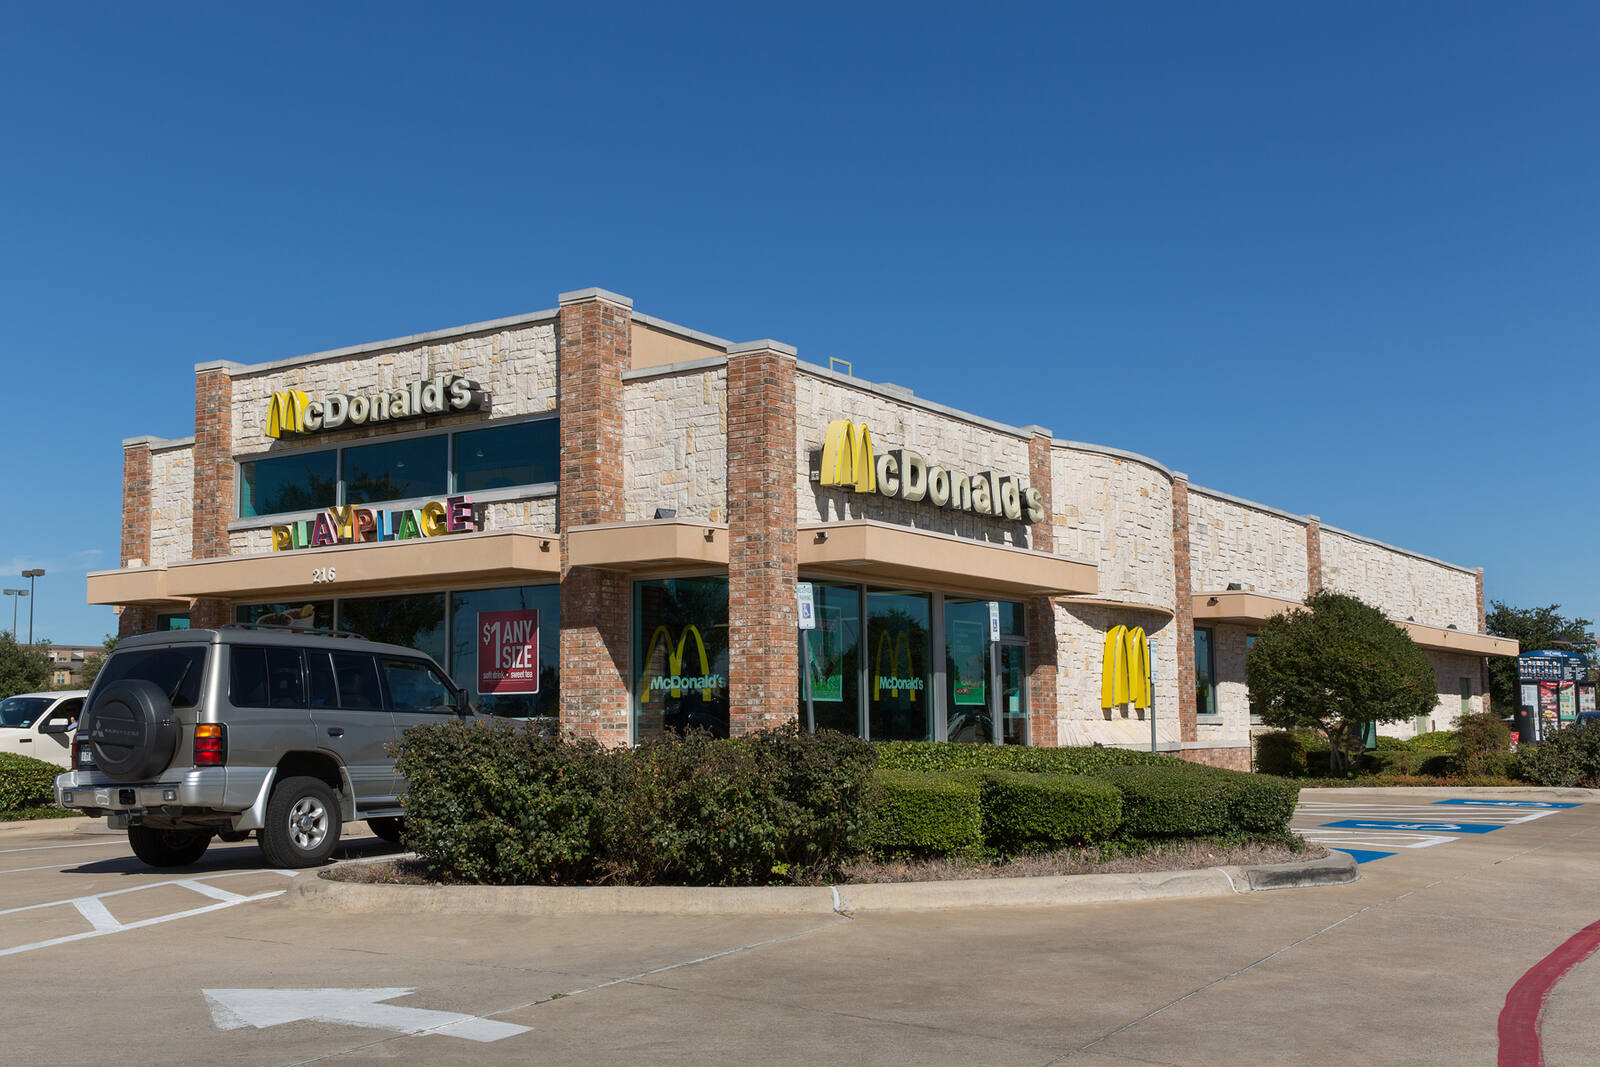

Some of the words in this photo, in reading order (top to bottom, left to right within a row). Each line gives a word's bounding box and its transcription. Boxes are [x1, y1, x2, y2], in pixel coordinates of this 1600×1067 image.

[265, 376, 472, 438] McDonald's
[272, 496, 474, 552] PLAYPLACE
[312, 567, 336, 583] 216
[483, 621, 501, 669] $1
[503, 620, 532, 643] ANY
[503, 645, 533, 669] SIZE
[650, 674, 726, 690] McDonald's
[879, 676, 924, 690] McDonald's
